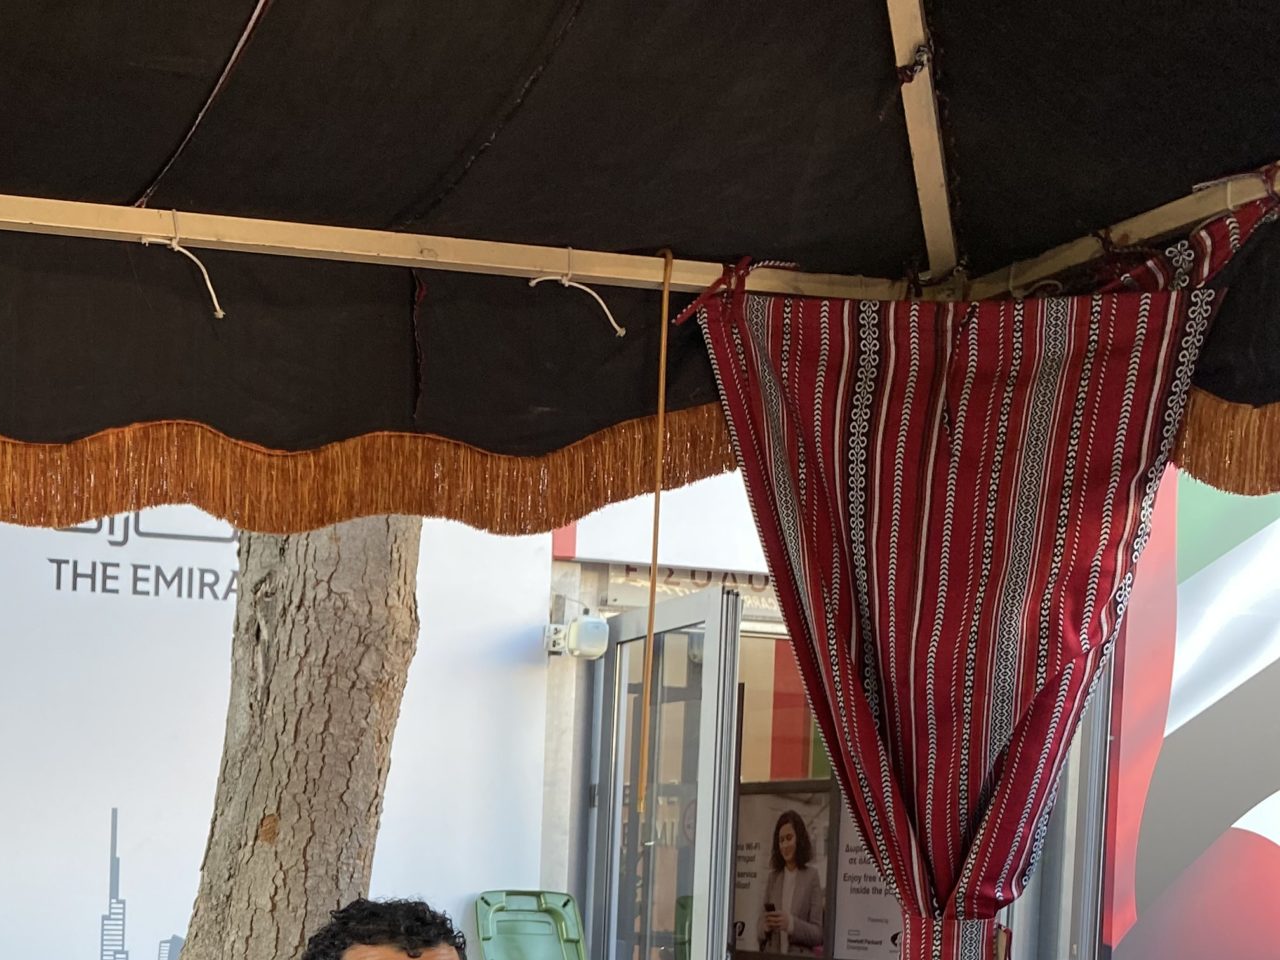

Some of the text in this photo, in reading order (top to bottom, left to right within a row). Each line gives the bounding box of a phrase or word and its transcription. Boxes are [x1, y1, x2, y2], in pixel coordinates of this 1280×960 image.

[47, 558, 120, 594] THE
[843, 872, 861, 884] Enjoy
[863, 873, 877, 882] free
[871, 887, 883, 895] the
